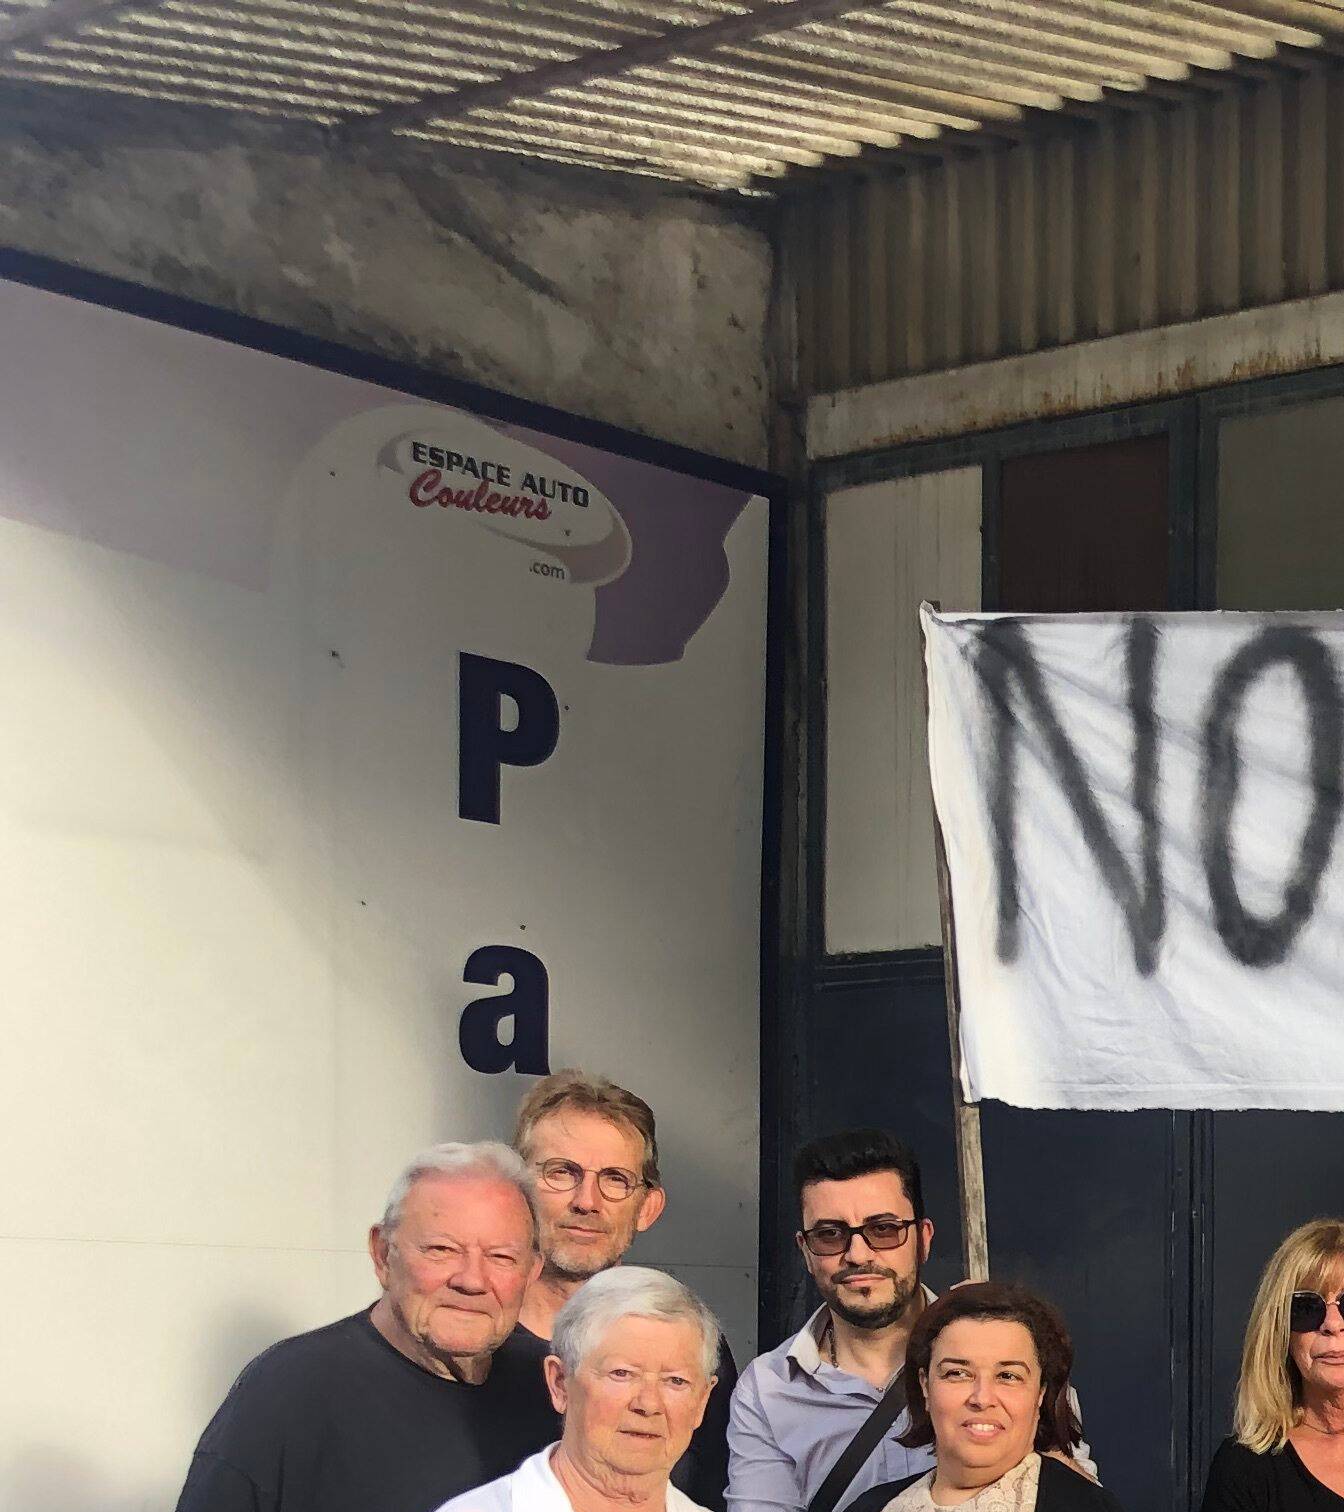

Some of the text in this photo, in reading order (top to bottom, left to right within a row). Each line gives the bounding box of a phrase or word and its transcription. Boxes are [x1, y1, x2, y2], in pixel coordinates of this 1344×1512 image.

[409, 468, 552, 521] Couleurs
[412, 441, 589, 508] ESPACE AUTO
[529, 561, 565, 580] .com
